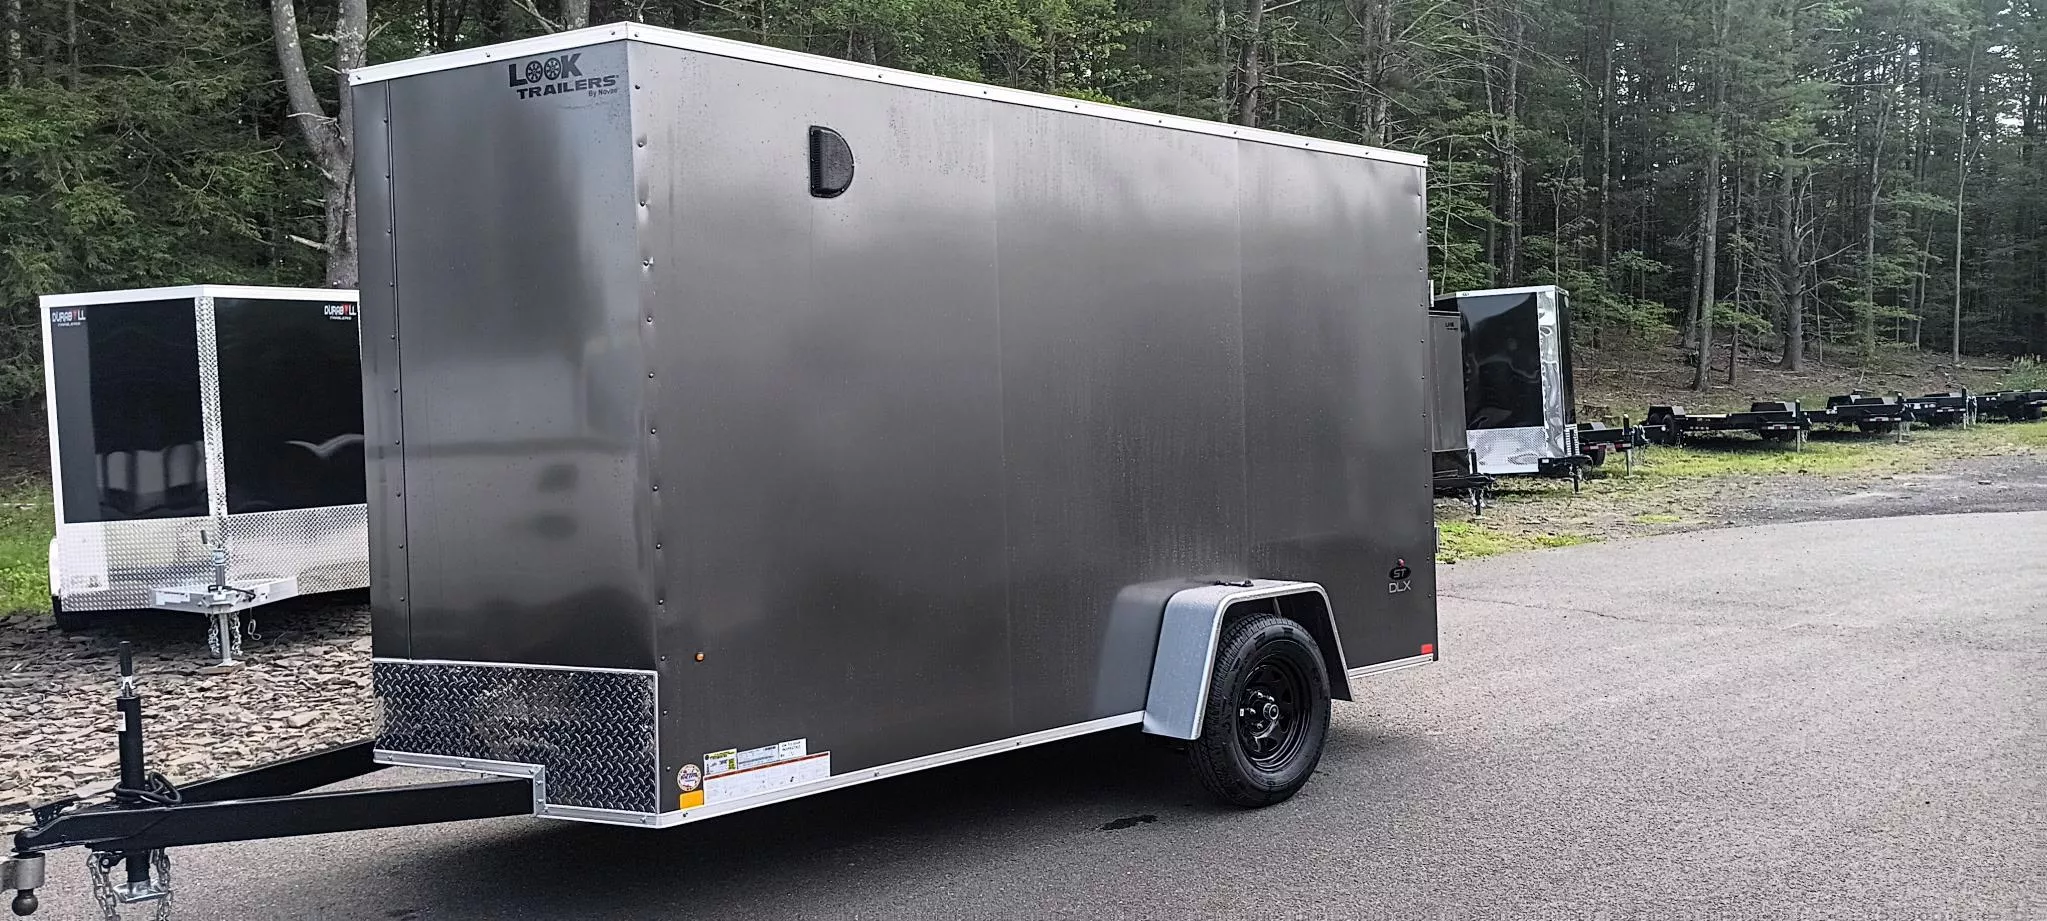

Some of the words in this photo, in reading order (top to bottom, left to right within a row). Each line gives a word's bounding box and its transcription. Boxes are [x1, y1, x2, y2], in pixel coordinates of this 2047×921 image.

[508, 53, 583, 87] LOOK
[516, 75, 617, 100] TRAILERS
[588, 89, 597, 98] By
[1393, 568, 1407, 578] ST
[1389, 580, 1411, 593] DLX
